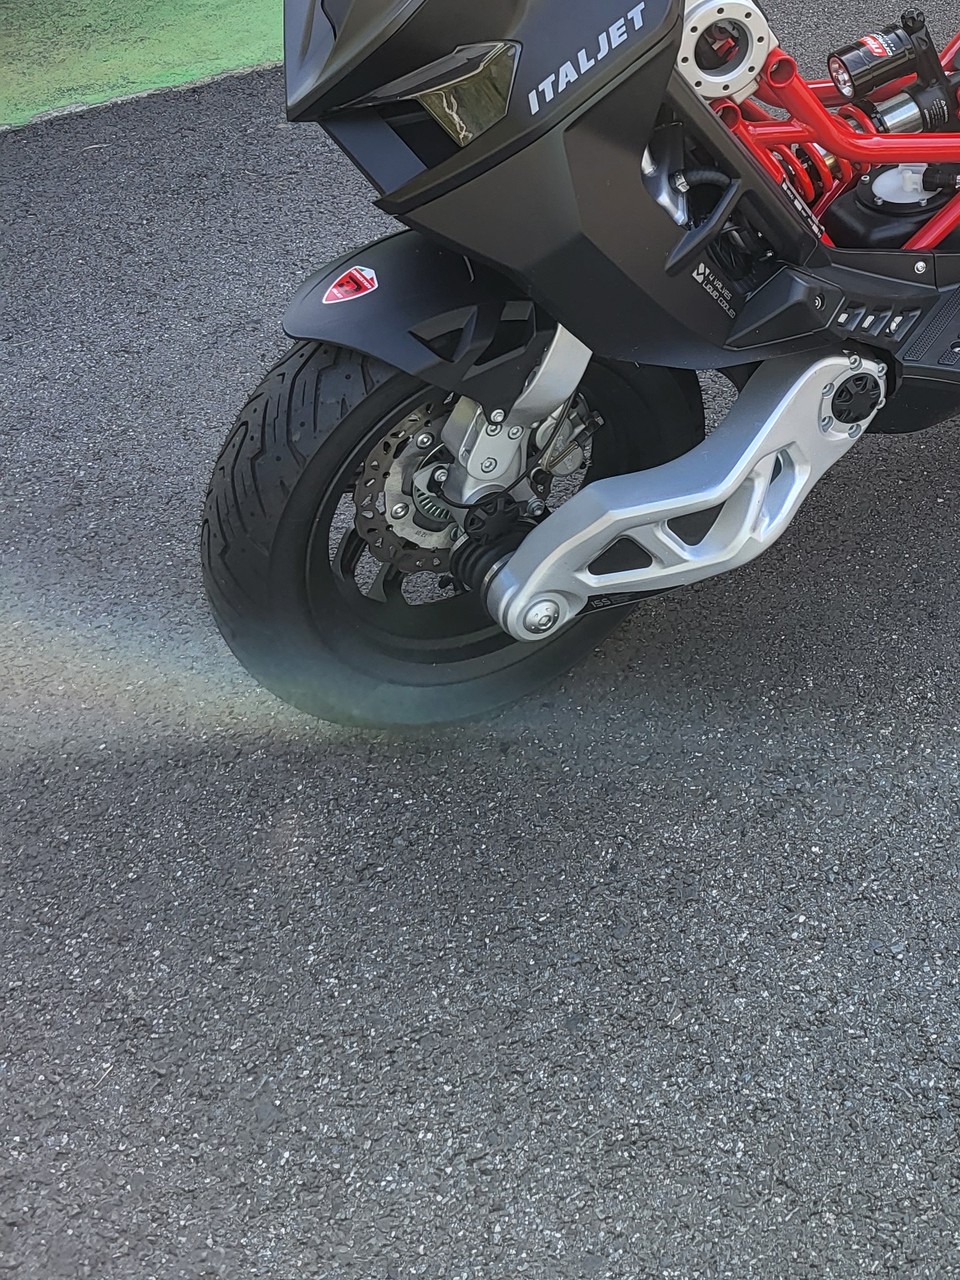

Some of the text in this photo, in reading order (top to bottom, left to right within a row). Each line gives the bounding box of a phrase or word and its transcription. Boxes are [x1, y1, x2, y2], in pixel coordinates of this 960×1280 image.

[528, 1, 646, 116] ITALJET
[702, 280, 736, 319] LIQUID COOLED
[713, 278, 733, 301] VALVES
